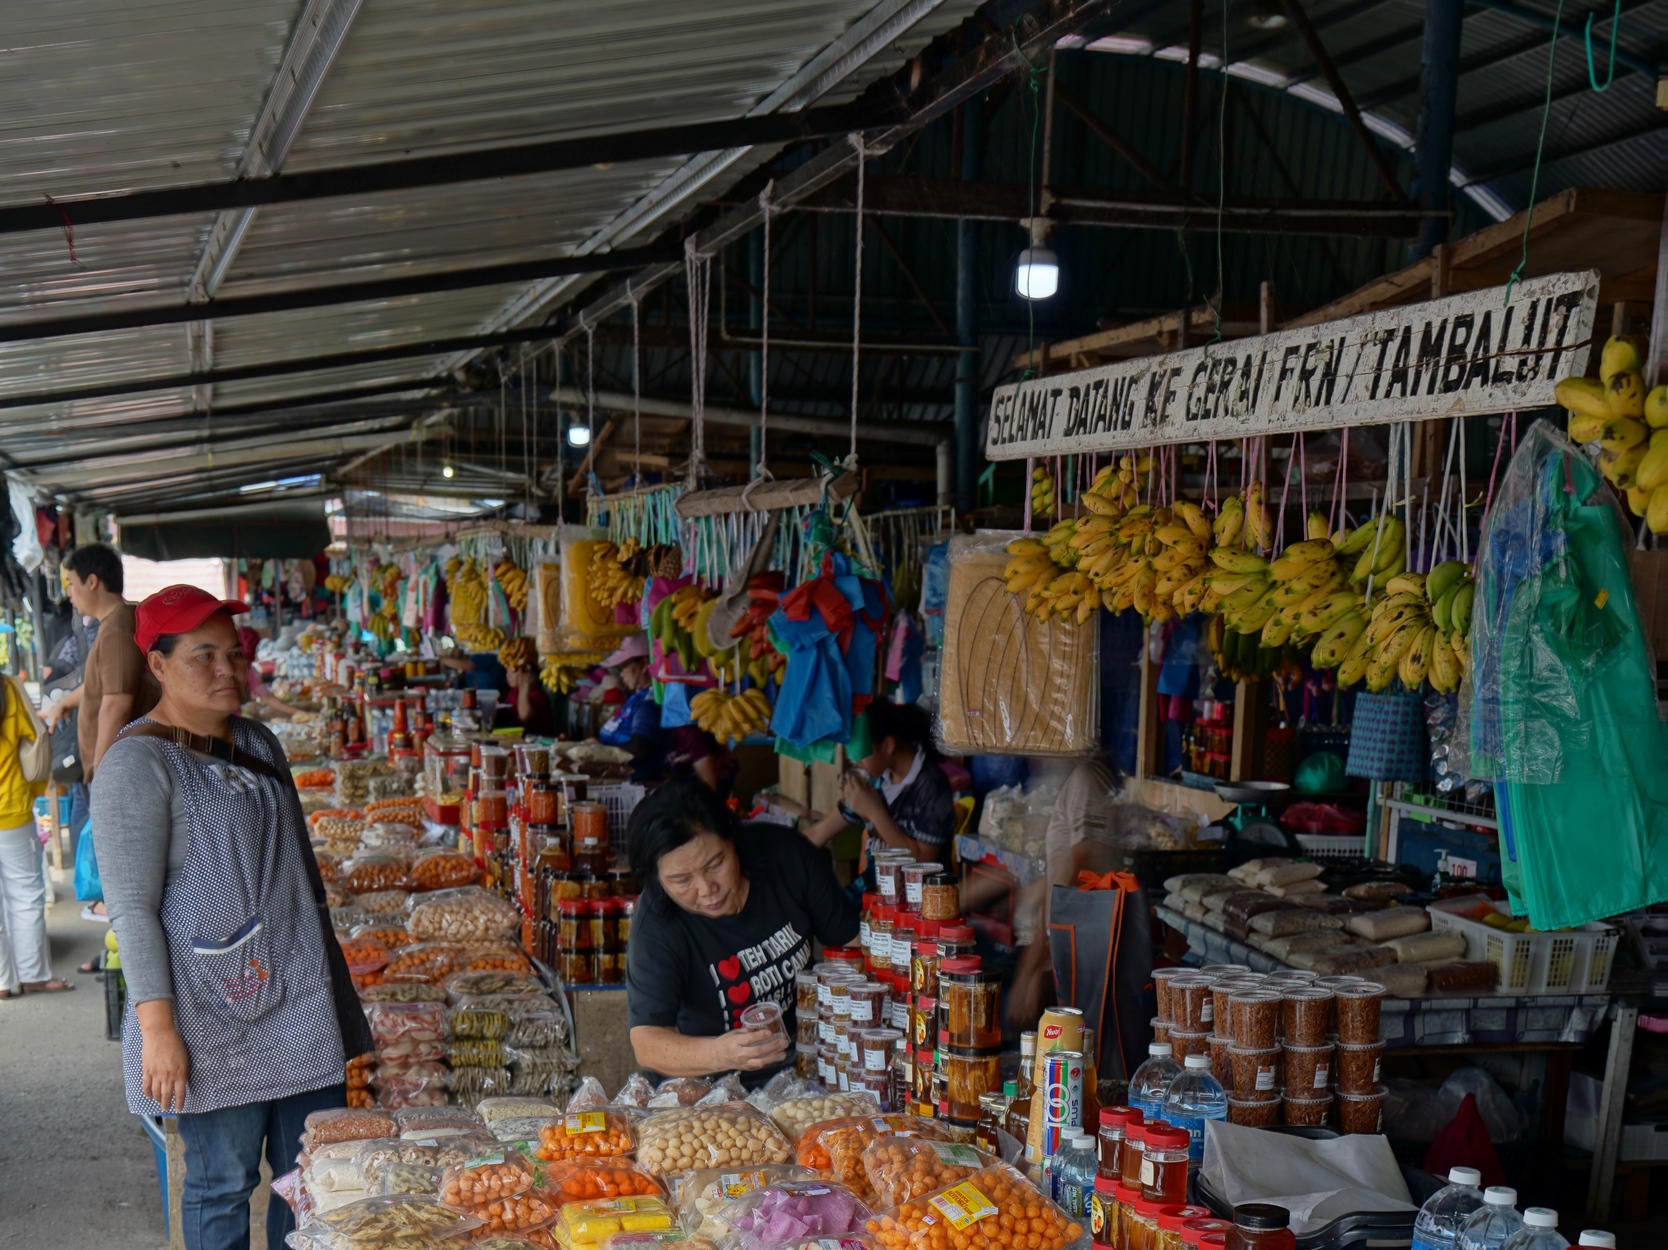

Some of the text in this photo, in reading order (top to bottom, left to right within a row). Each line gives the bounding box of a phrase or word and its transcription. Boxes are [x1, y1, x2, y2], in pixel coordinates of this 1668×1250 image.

[990, 387, 1064, 446] SELAMAT
[1062, 375, 1140, 438] DATANG
[1141, 365, 1184, 430] KE
[1185, 348, 1269, 423] GERAI
[1360, 291, 1586, 401] TAMBALUT
[709, 921, 802, 988] I TEH TARIK
[718, 989, 727, 1009] I
[750, 964, 783, 998] ROTI
[1071, 1099, 1079, 1128] PLUS
